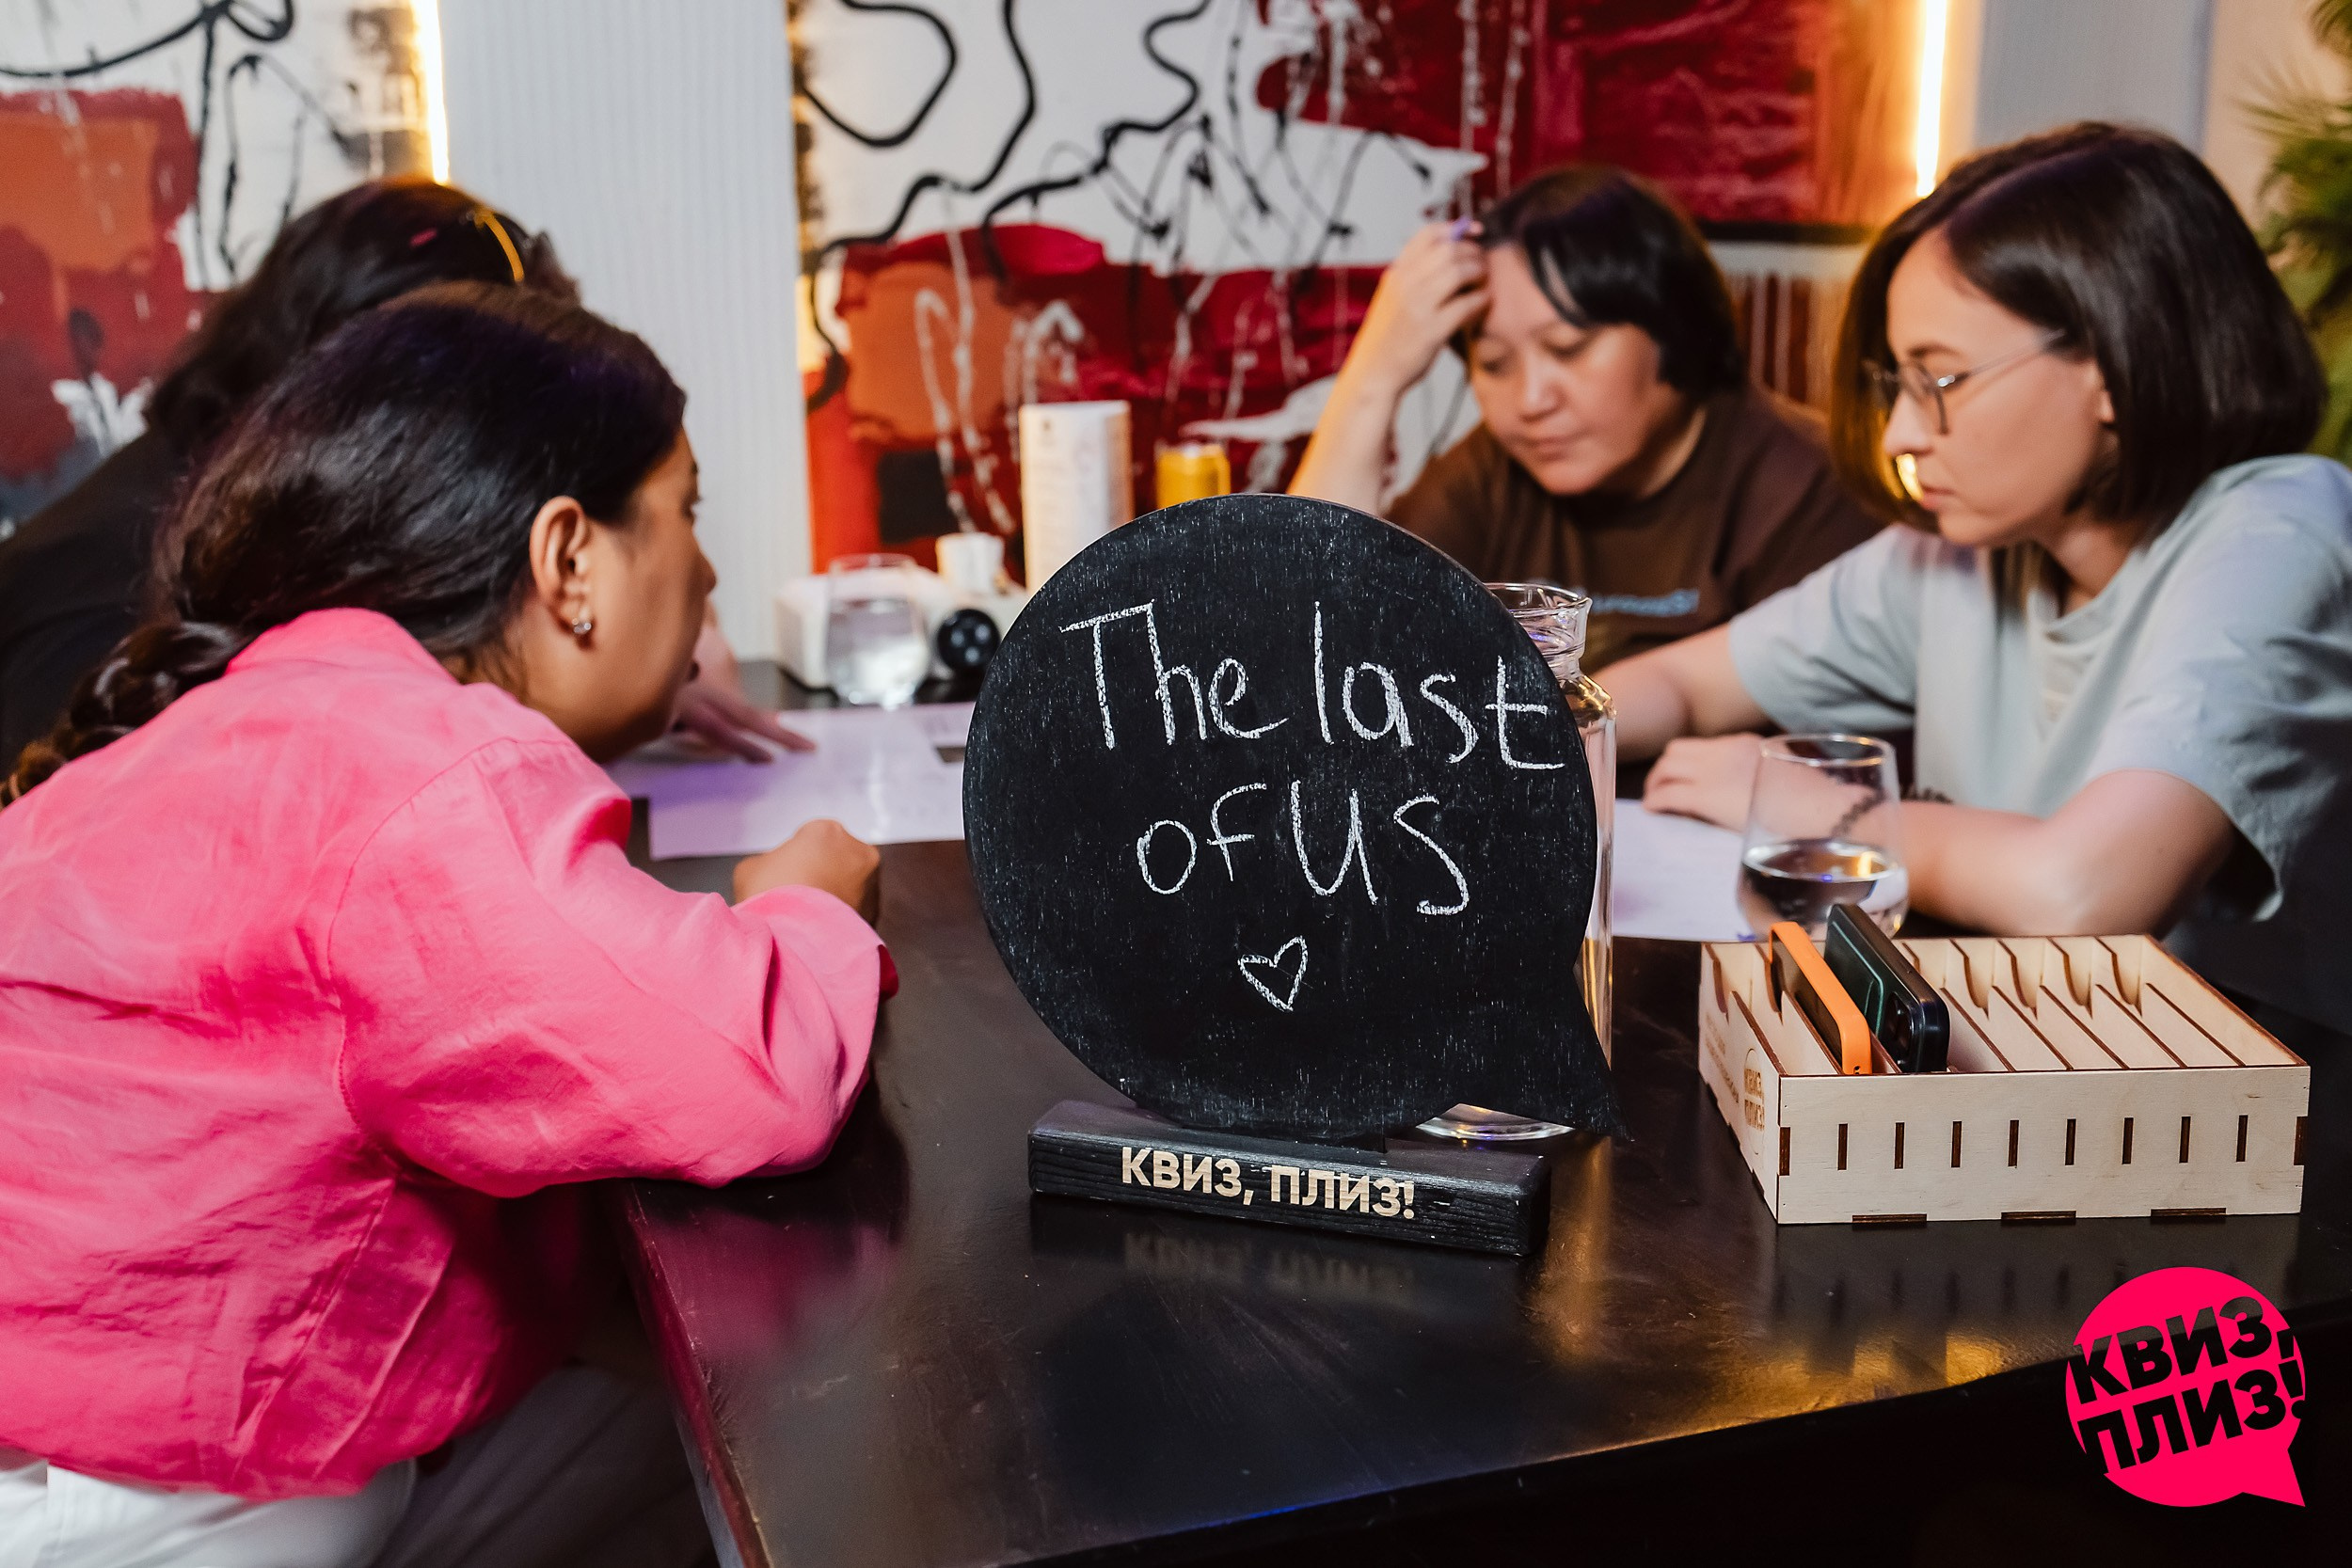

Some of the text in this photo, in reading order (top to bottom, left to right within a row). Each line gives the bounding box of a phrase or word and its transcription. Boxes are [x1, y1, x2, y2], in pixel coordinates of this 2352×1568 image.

[1059, 599, 1565, 769] The last
[1136, 783, 1267, 895] of
[1121, 1146, 1415, 1220] КВИЗ, ПЛИЗ!
